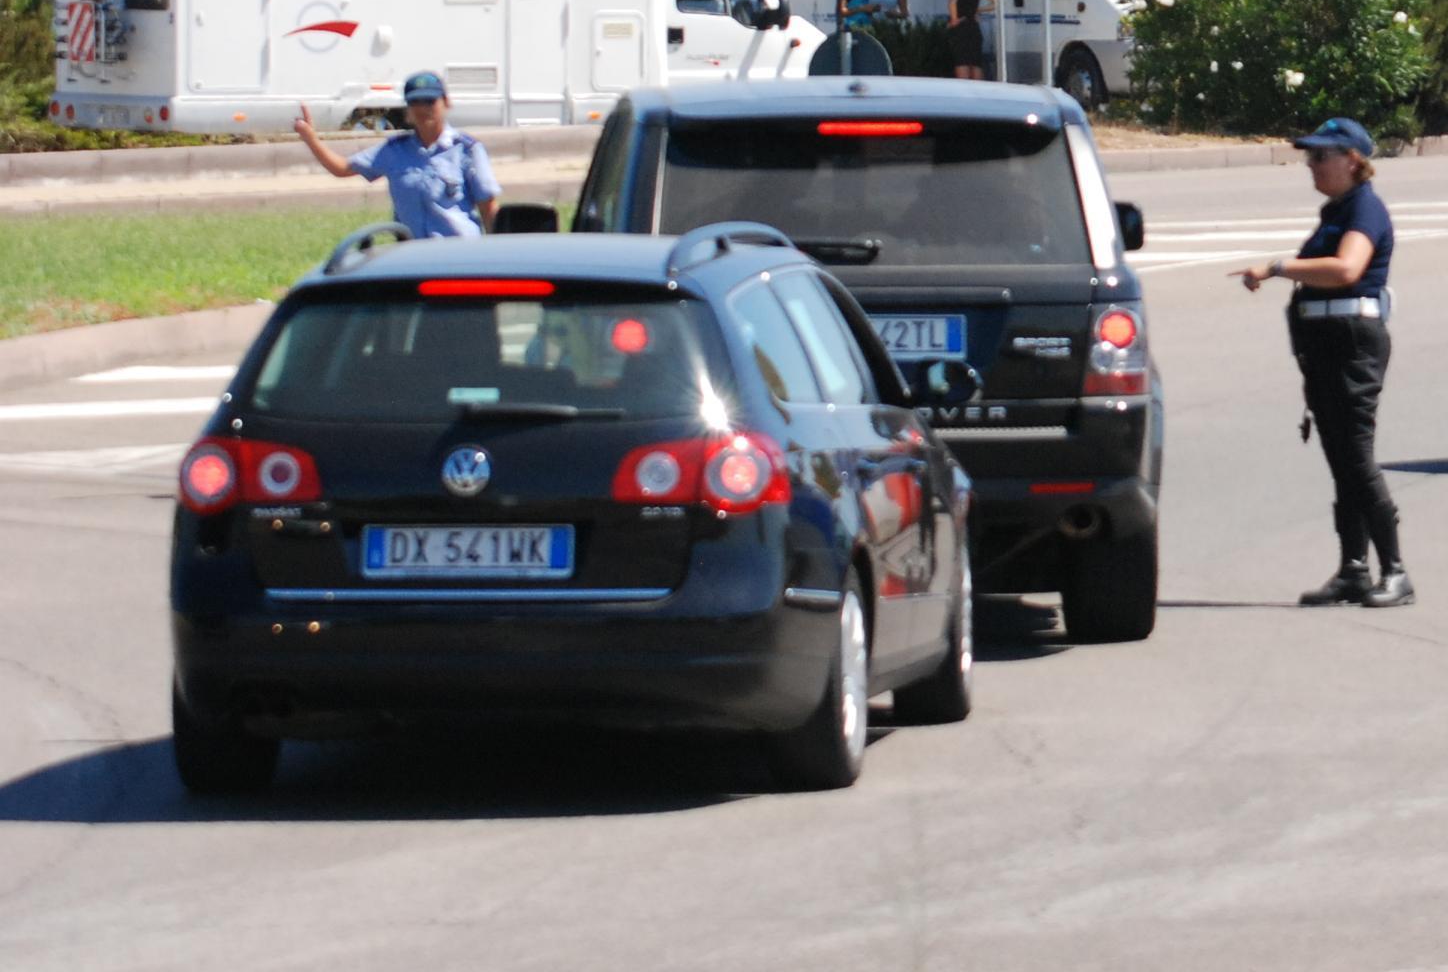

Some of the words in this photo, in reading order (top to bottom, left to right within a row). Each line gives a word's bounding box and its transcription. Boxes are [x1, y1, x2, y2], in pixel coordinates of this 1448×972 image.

[880, 320, 943, 349] 42TL
[916, 406, 1007, 422] OVER
[390, 531, 430, 563] DX
[445, 531, 545, 563] 541WK
